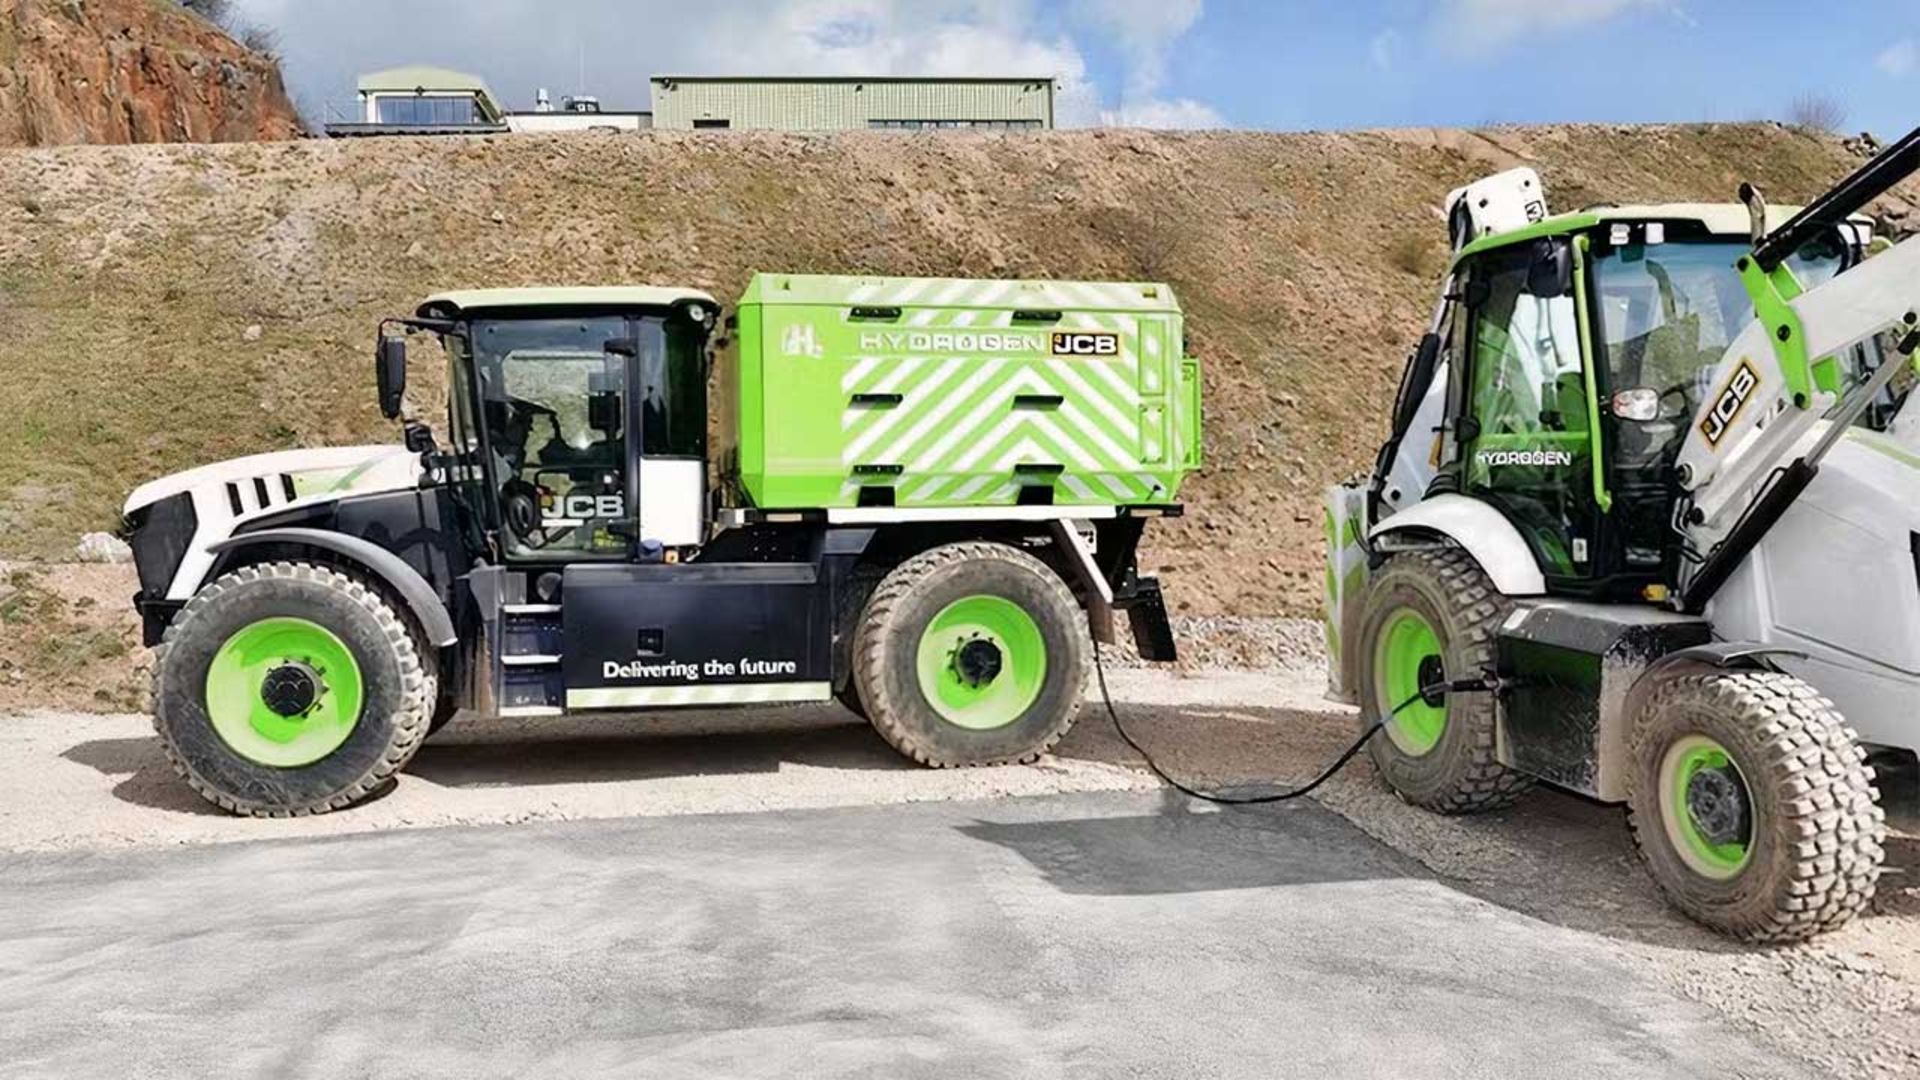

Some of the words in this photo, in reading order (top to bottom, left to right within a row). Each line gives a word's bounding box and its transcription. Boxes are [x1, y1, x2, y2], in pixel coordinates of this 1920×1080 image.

[859, 332, 1045, 351] HYDROGEN
[1053, 333, 1118, 355] JCB
[1702, 363, 1759, 444] JCB
[1475, 450, 1572, 466] HYDROGEN
[540, 494, 624, 518] JCB
[603, 660, 699, 680] Delivering
[703, 660, 735, 676] the
[739, 658, 796, 675] future
